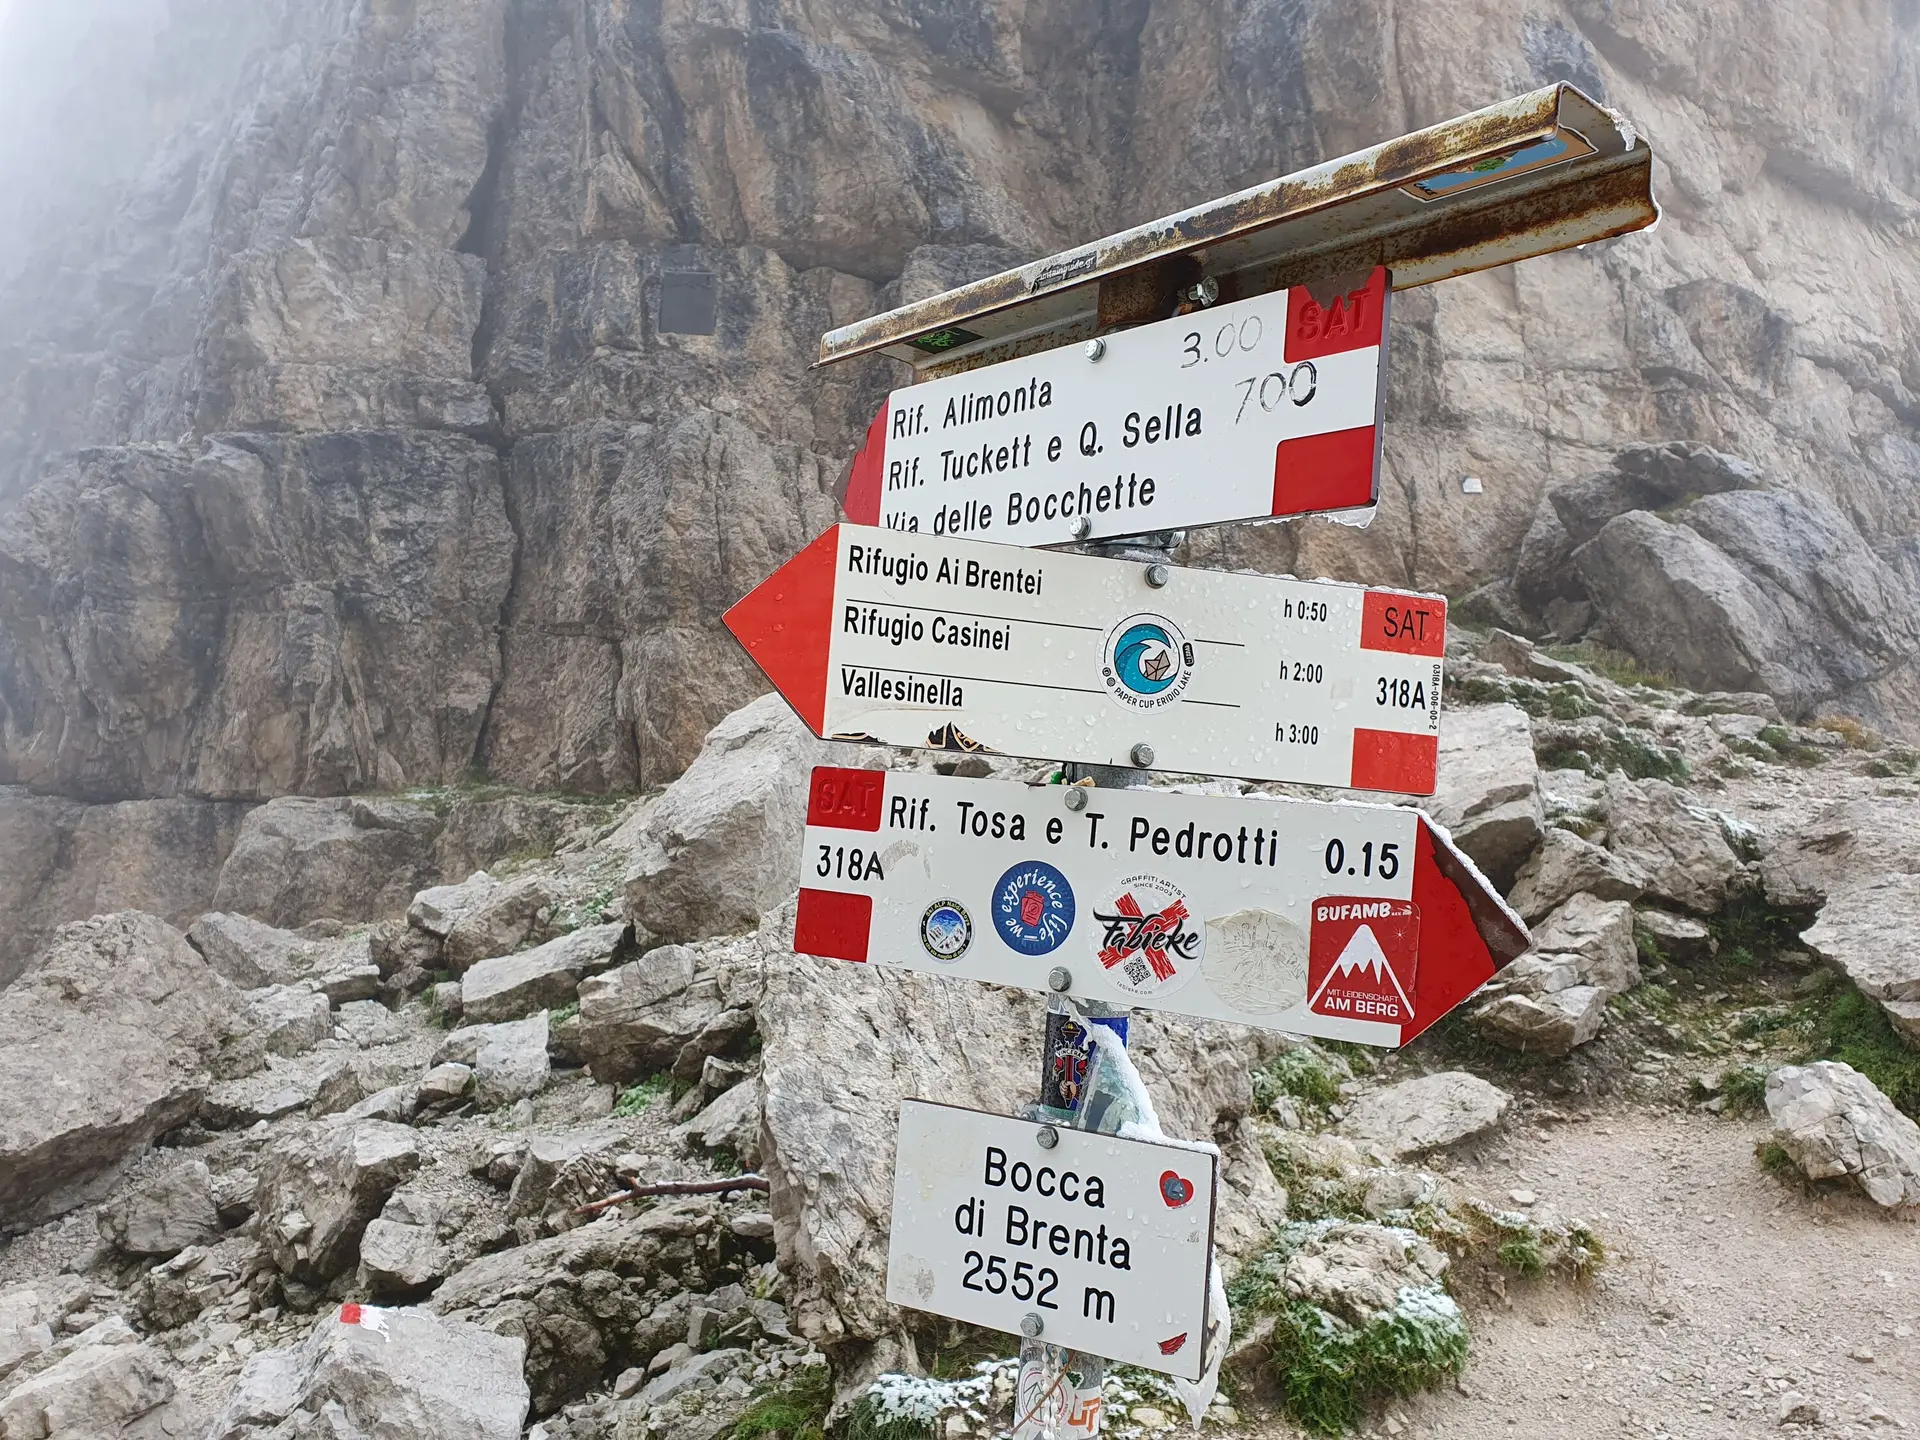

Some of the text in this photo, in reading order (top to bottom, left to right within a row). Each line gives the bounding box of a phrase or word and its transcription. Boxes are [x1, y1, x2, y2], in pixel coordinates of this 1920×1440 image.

[1298, 288, 1372, 343] SAT
[1181, 316, 1263, 369] 3.00
[892, 376, 1052, 440] Rif. Alimonta
[1234, 361, 1317, 425] 700
[888, 403, 1203, 492] Rif. Tuckett e Q. Sella
[886, 471, 1156, 535] Via delle Bocchette
[848, 544, 1043, 596] Rifugio Ai Brentei
[843, 605, 1011, 652] Rifugio Casinei
[1283, 598, 1327, 623] h 0:50
[1383, 606, 1430, 641] SAT
[841, 668, 964, 707] Vallesinella
[1113, 670, 1192, 708] PAPER CUP ERIDIO LAKE
[1279, 660, 1323, 684] h 2:00
[1376, 676, 1426, 710] 318A
[1275, 722, 1319, 746] h 3:00
[818, 778, 876, 816] SAT
[889, 795, 1399, 880] Rif. Tosa e T. Pedrotti 0.15
[816, 844, 885, 882] 318A
[1001, 868, 1068, 946] we experience life
[1120, 875, 1187, 900] GRAFFITI ARTIST
[1155, 884, 1173, 897] 2003
[1316, 901, 1392, 922] BUFAMB
[1324, 996, 1399, 1017] AM BERG
[1327, 988, 1400, 1003] MIT LEIDENSCHAFT
[983, 1146, 1106, 1209] Bocca
[954, 1196, 1132, 1271] di Brenta
[962, 1249, 1115, 1324] 2552 m
